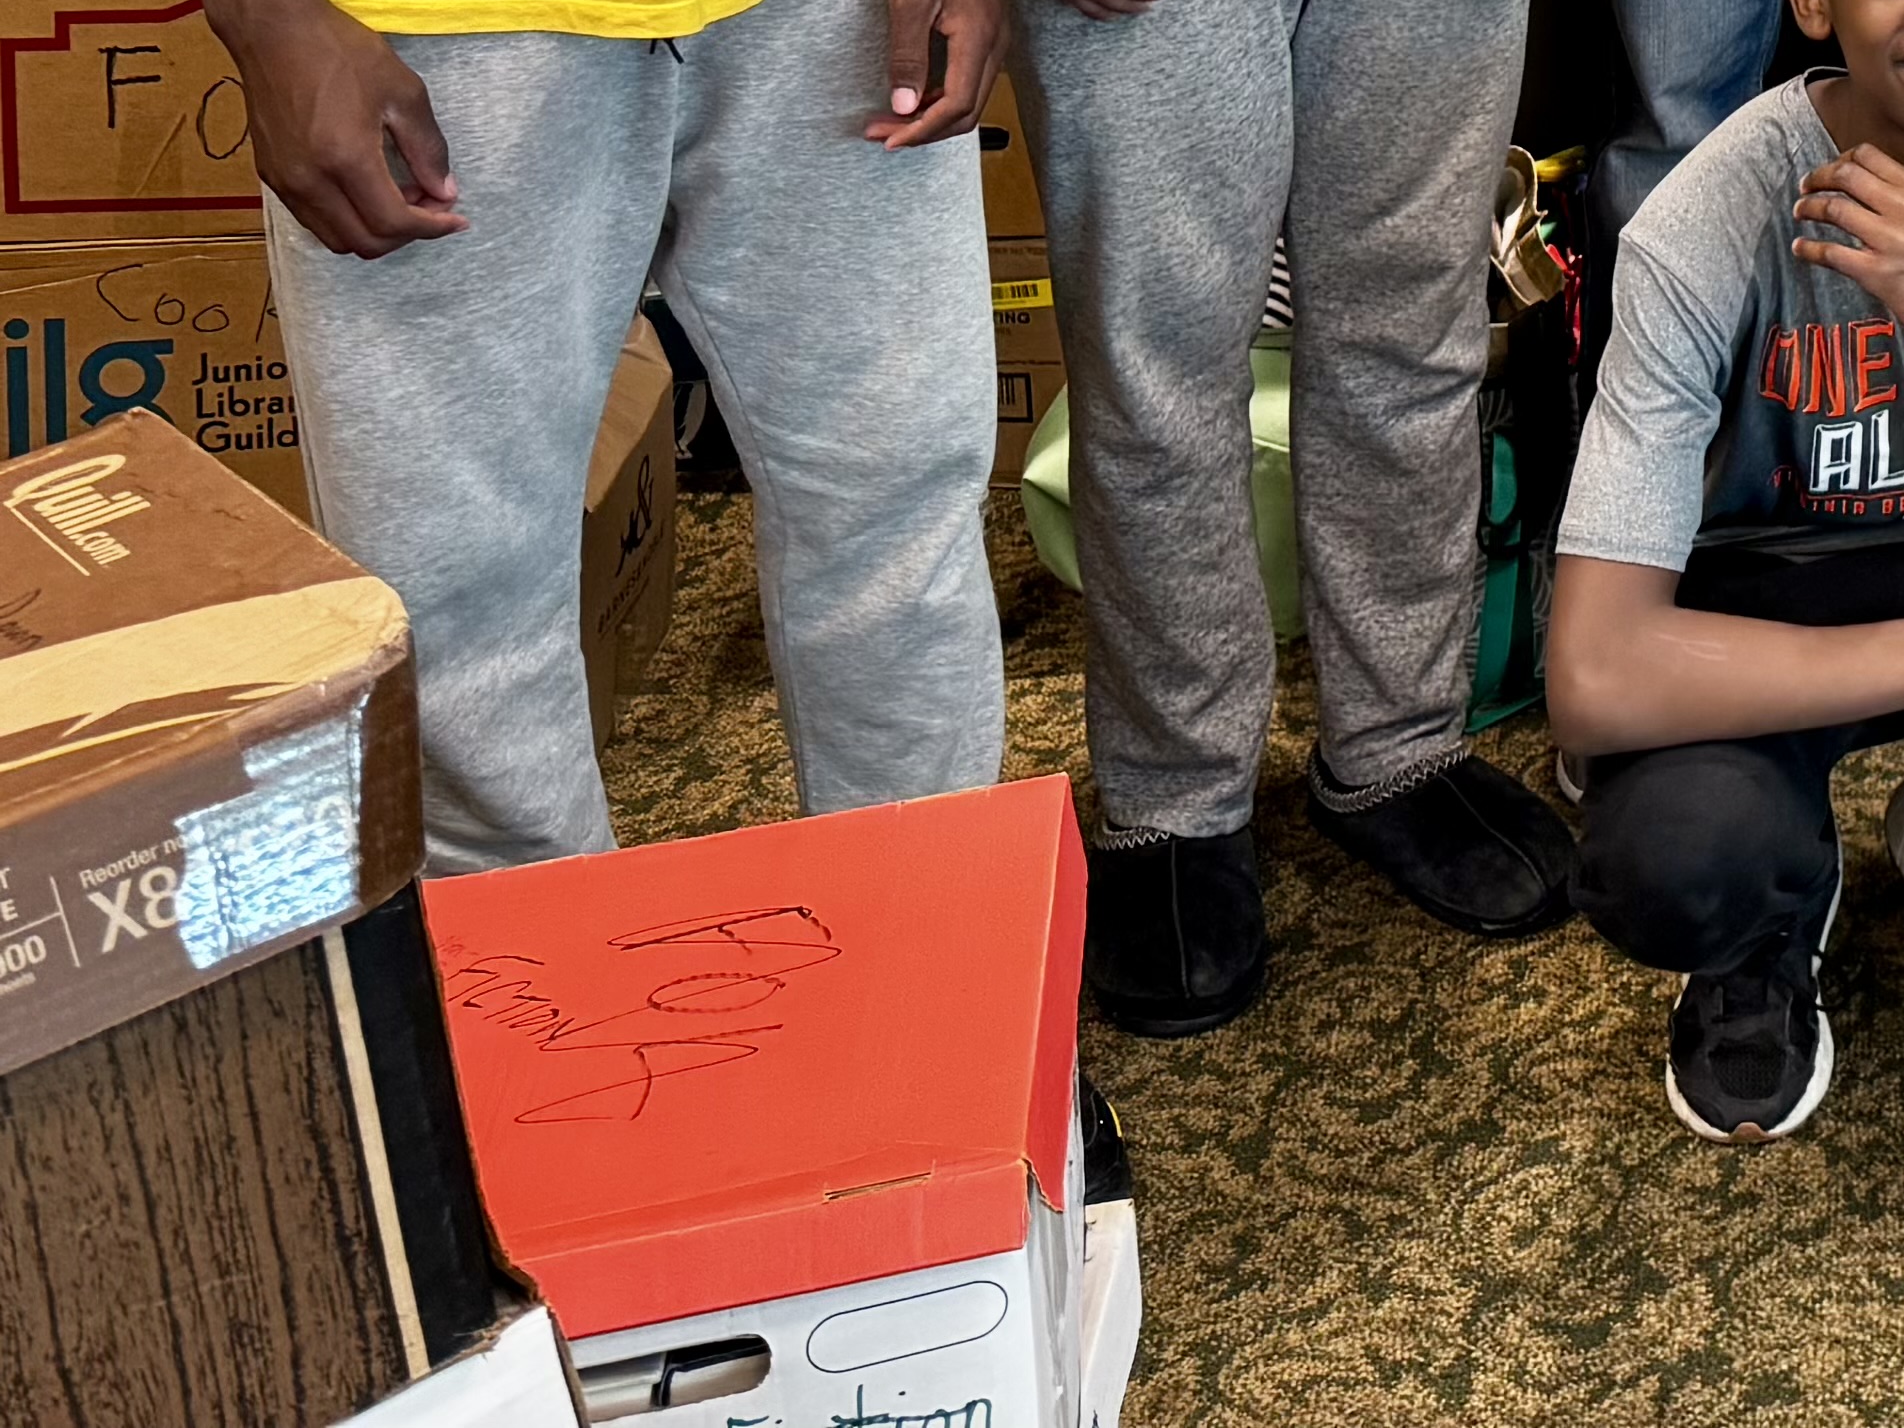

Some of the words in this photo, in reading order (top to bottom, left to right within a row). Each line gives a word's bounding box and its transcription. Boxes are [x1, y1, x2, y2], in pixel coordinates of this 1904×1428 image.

[191, 352, 288, 386] Junio
[1758, 318, 1897, 417] ONE
[195, 417, 300, 454] Guild
[3, 453, 152, 566] Quill.com
[79, 847, 159, 889] Reorder
